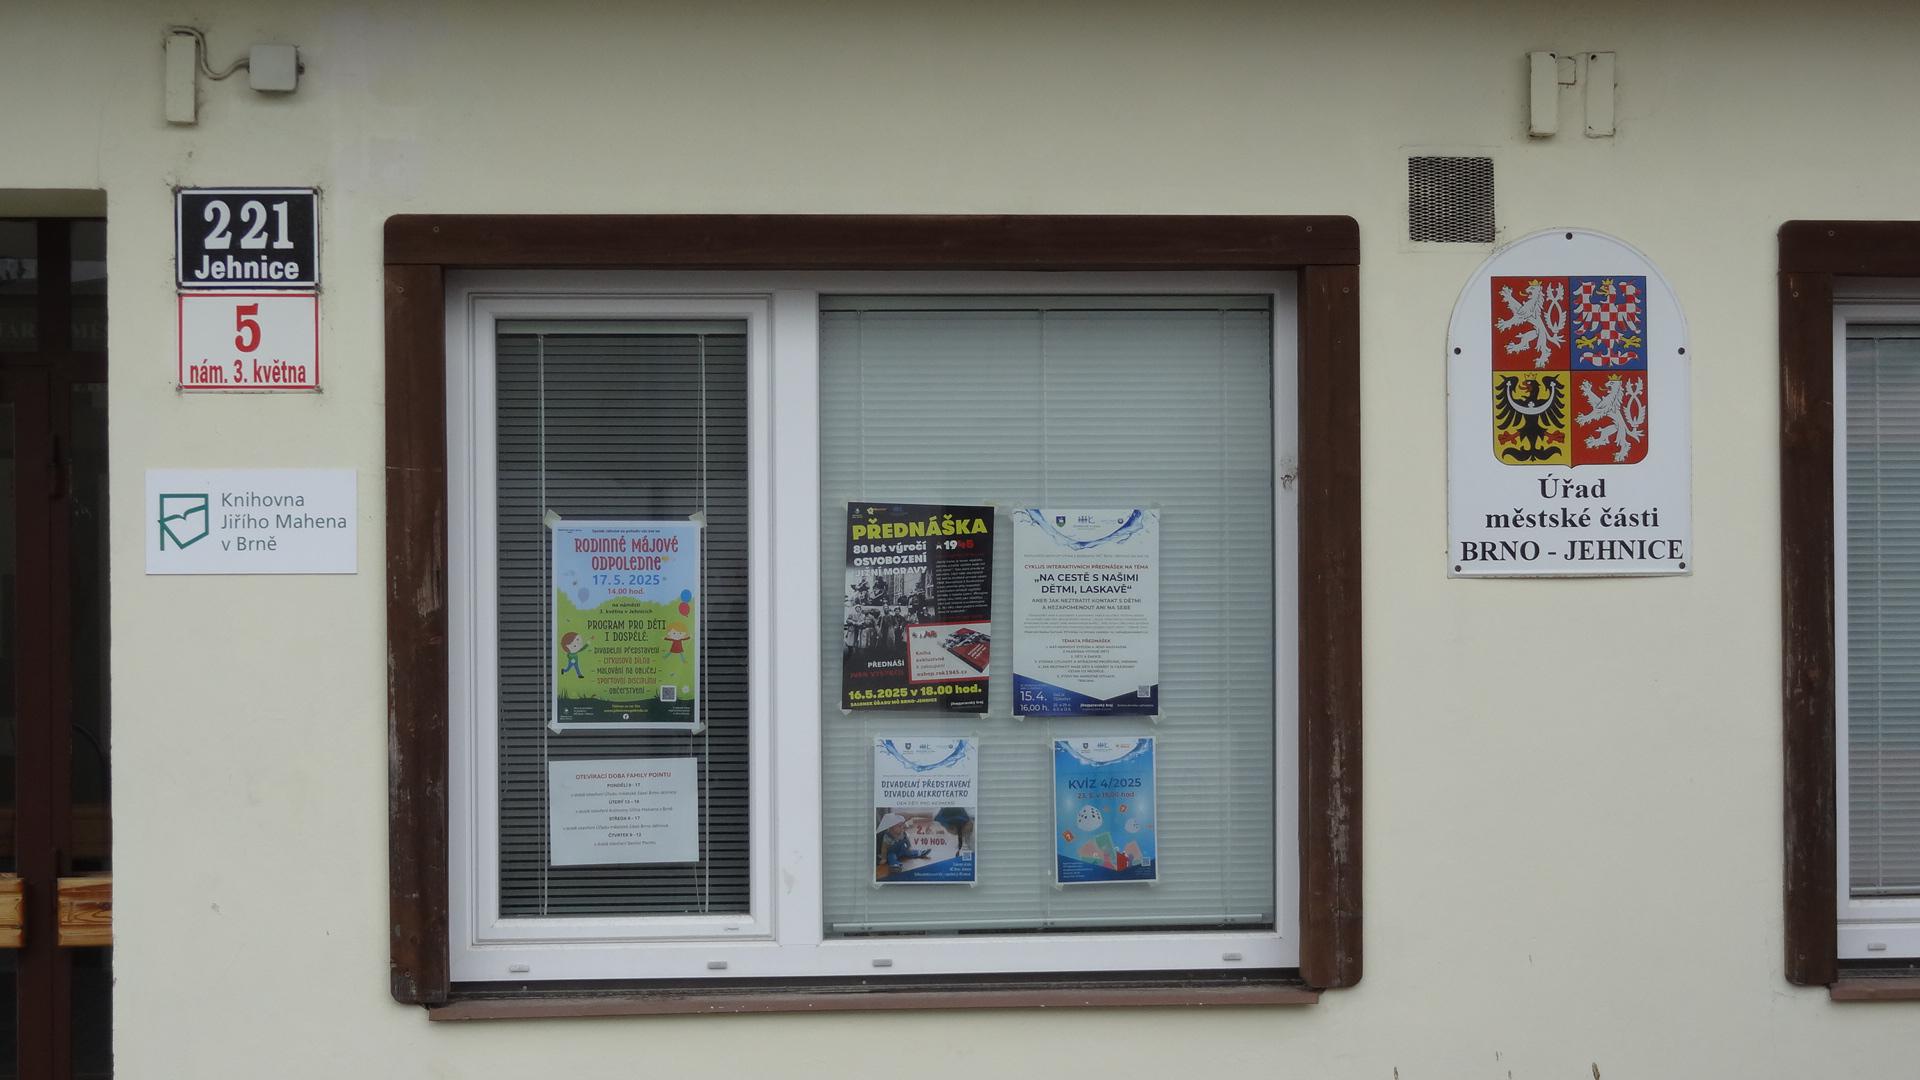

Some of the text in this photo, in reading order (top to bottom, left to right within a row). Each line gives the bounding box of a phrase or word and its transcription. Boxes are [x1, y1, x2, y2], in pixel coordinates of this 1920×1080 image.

[204, 200, 293, 250] 221
[195, 255, 299, 280] Jehnice
[234, 303, 261, 352] 5
[190, 359, 306, 384] nám. 3. května
[1538, 473, 1606, 499] Úřad
[222, 492, 304, 507] Knihovna
[221, 513, 347, 530] Jiřího Mahena
[1486, 507, 1659, 528] městské části
[852, 514, 987, 540] PŘEDNÁŠKA
[222, 536, 277, 551] v Brně
[853, 540, 926, 554] 80 let výročí
[1461, 540, 1540, 561] BRNO
[1564, 539, 1683, 560] JEHNICE
[854, 554, 927, 566] OSVOBOZENÍ
[856, 566, 927, 577] JIŽNÍ MORAVY
[1057, 572, 1090, 582] CESTĚ
[1102, 572, 1139, 582] NAŠIMI
[629, 574, 660, 585] 2025
[1041, 585, 1077, 594] DĚTMI,
[588, 618, 666, 629] PROGRAM PRO DĚTI
[605, 633, 609, 641] I
[849, 688, 907, 700] 16.5.2025
[920, 686, 952, 696] 18.00
[956, 684, 982, 693] hod.
[882, 778, 971, 788] DIVADELNÍ PŘEDSTAVENÍ
[1069, 778, 1142, 790] KVÍZ 4/2025
